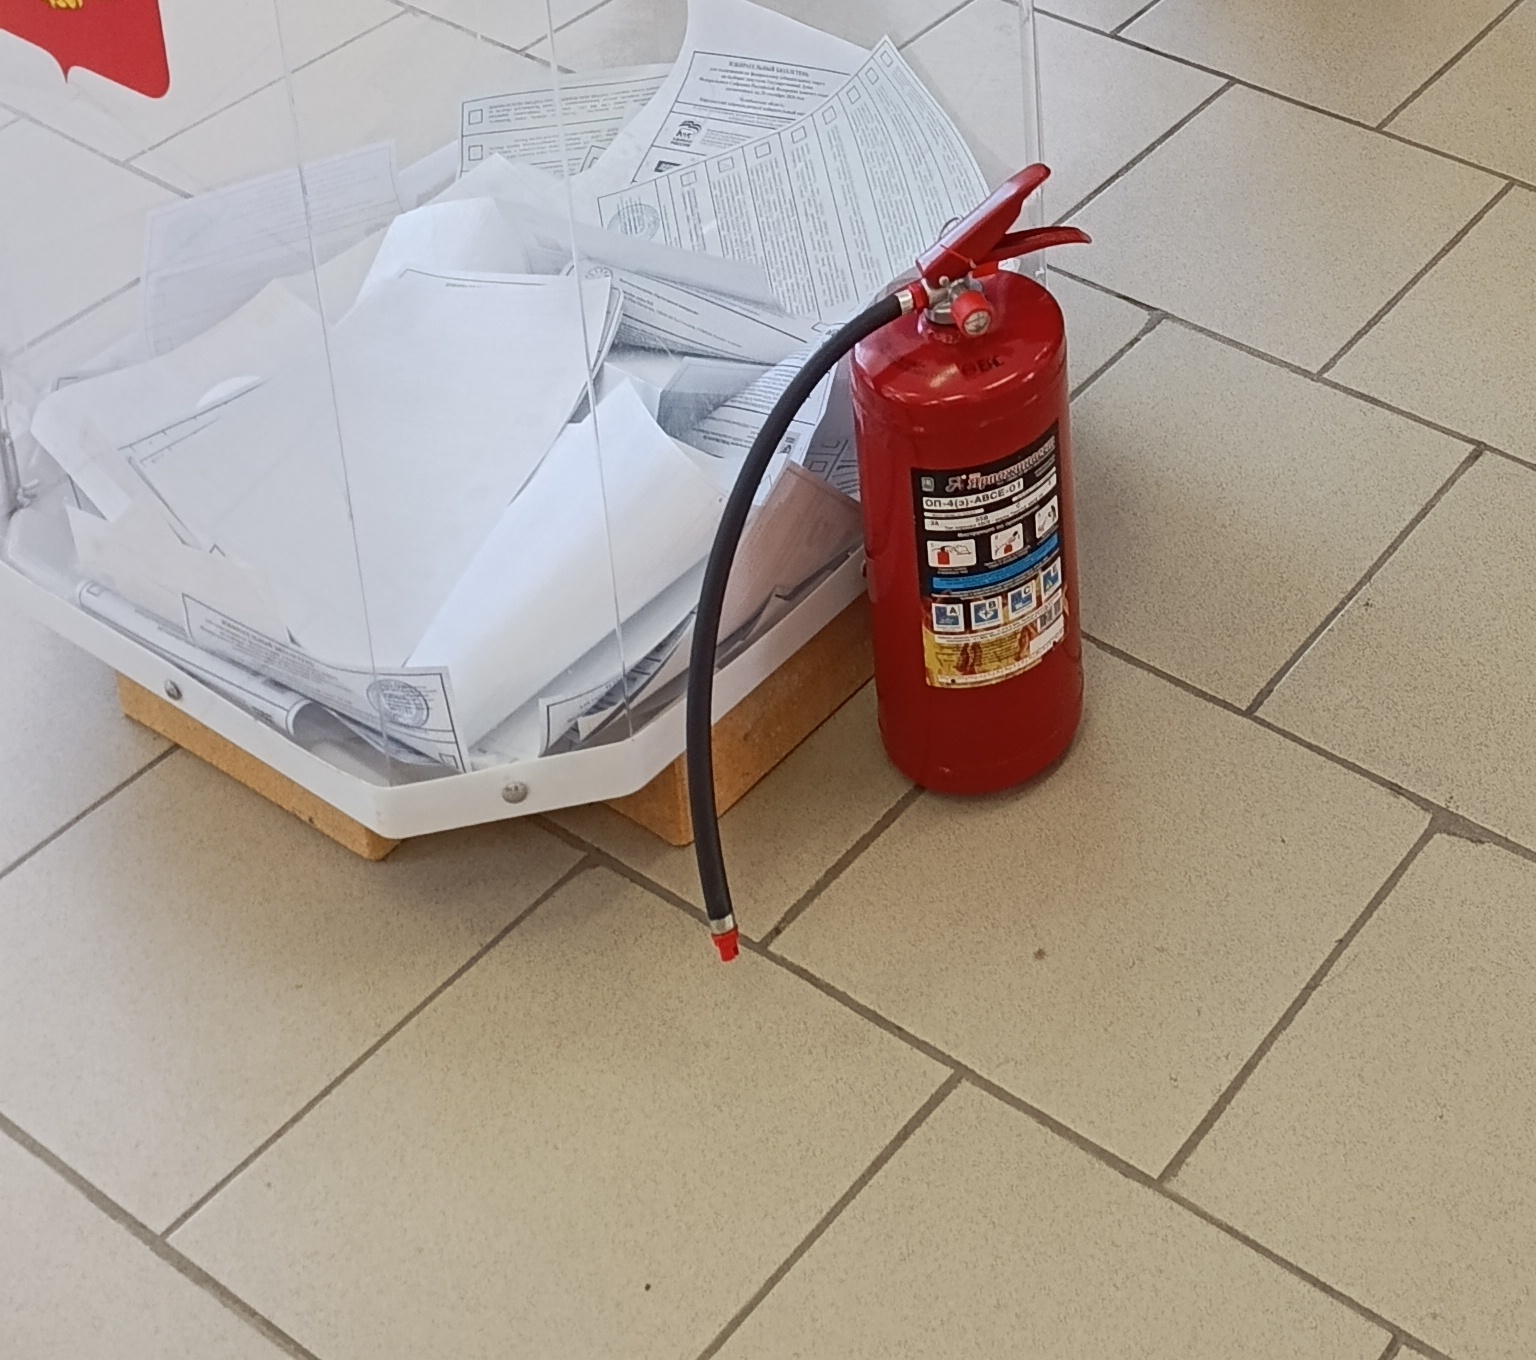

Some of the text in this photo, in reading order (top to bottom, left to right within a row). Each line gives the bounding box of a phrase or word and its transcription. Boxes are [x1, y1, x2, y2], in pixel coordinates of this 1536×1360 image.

[949, 607, 957, 615] A
[988, 601, 997, 609] B
[1023, 586, 1031, 596] C
